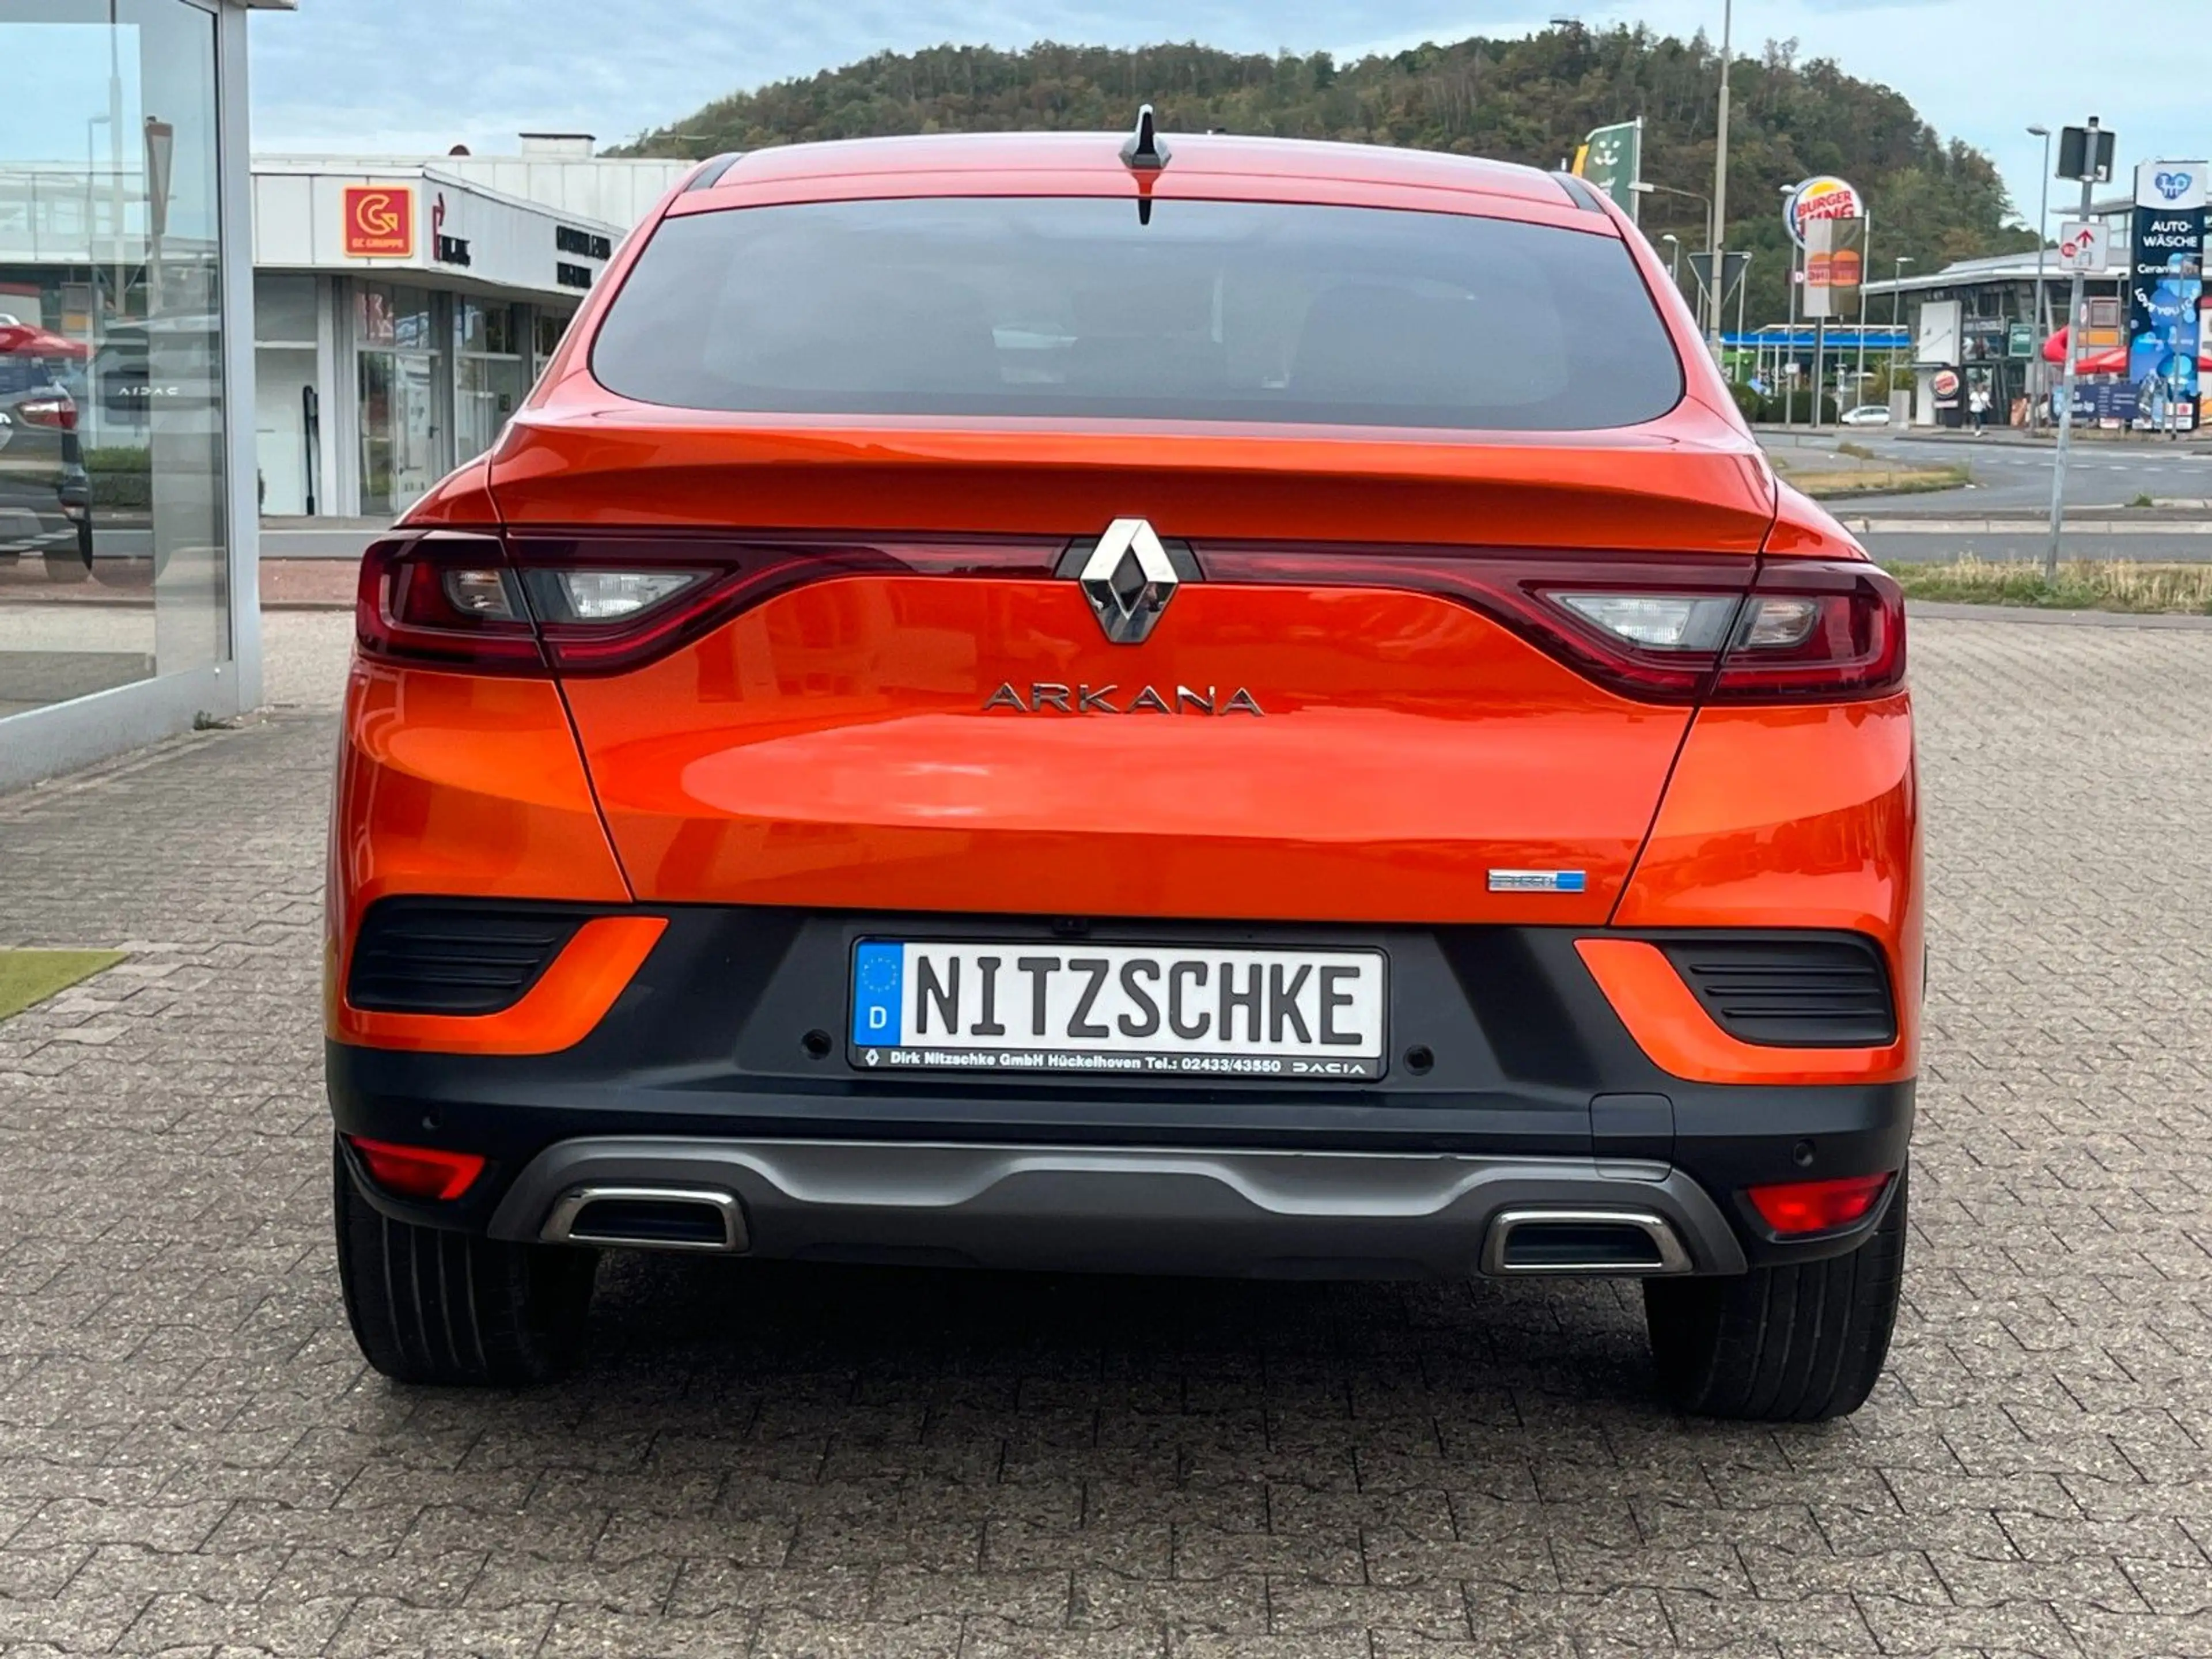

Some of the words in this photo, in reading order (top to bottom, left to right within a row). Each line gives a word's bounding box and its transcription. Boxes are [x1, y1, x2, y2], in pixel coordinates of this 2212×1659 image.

[1797, 191, 1851, 217] BURGER
[2151, 221, 2192, 232] AUTO-
[2143, 234, 2198, 248] WÄSCHE
[982, 682, 1265, 717] ARKANA
[916, 956, 1363, 1045] NITZSCHKE
[870, 1006, 887, 1029] D
[891, 1052, 921, 1065] Dirk
[924, 1052, 995, 1066] Nitzschke
[999, 1054, 1044, 1067] GmbH
[1048, 1055, 1141, 1070] Hückelhoven
[1145, 1056, 1178, 1070] Tel.:
[1181, 1059, 1281, 1072] 02433/43550
[1292, 1062, 1365, 1074] DACIA
